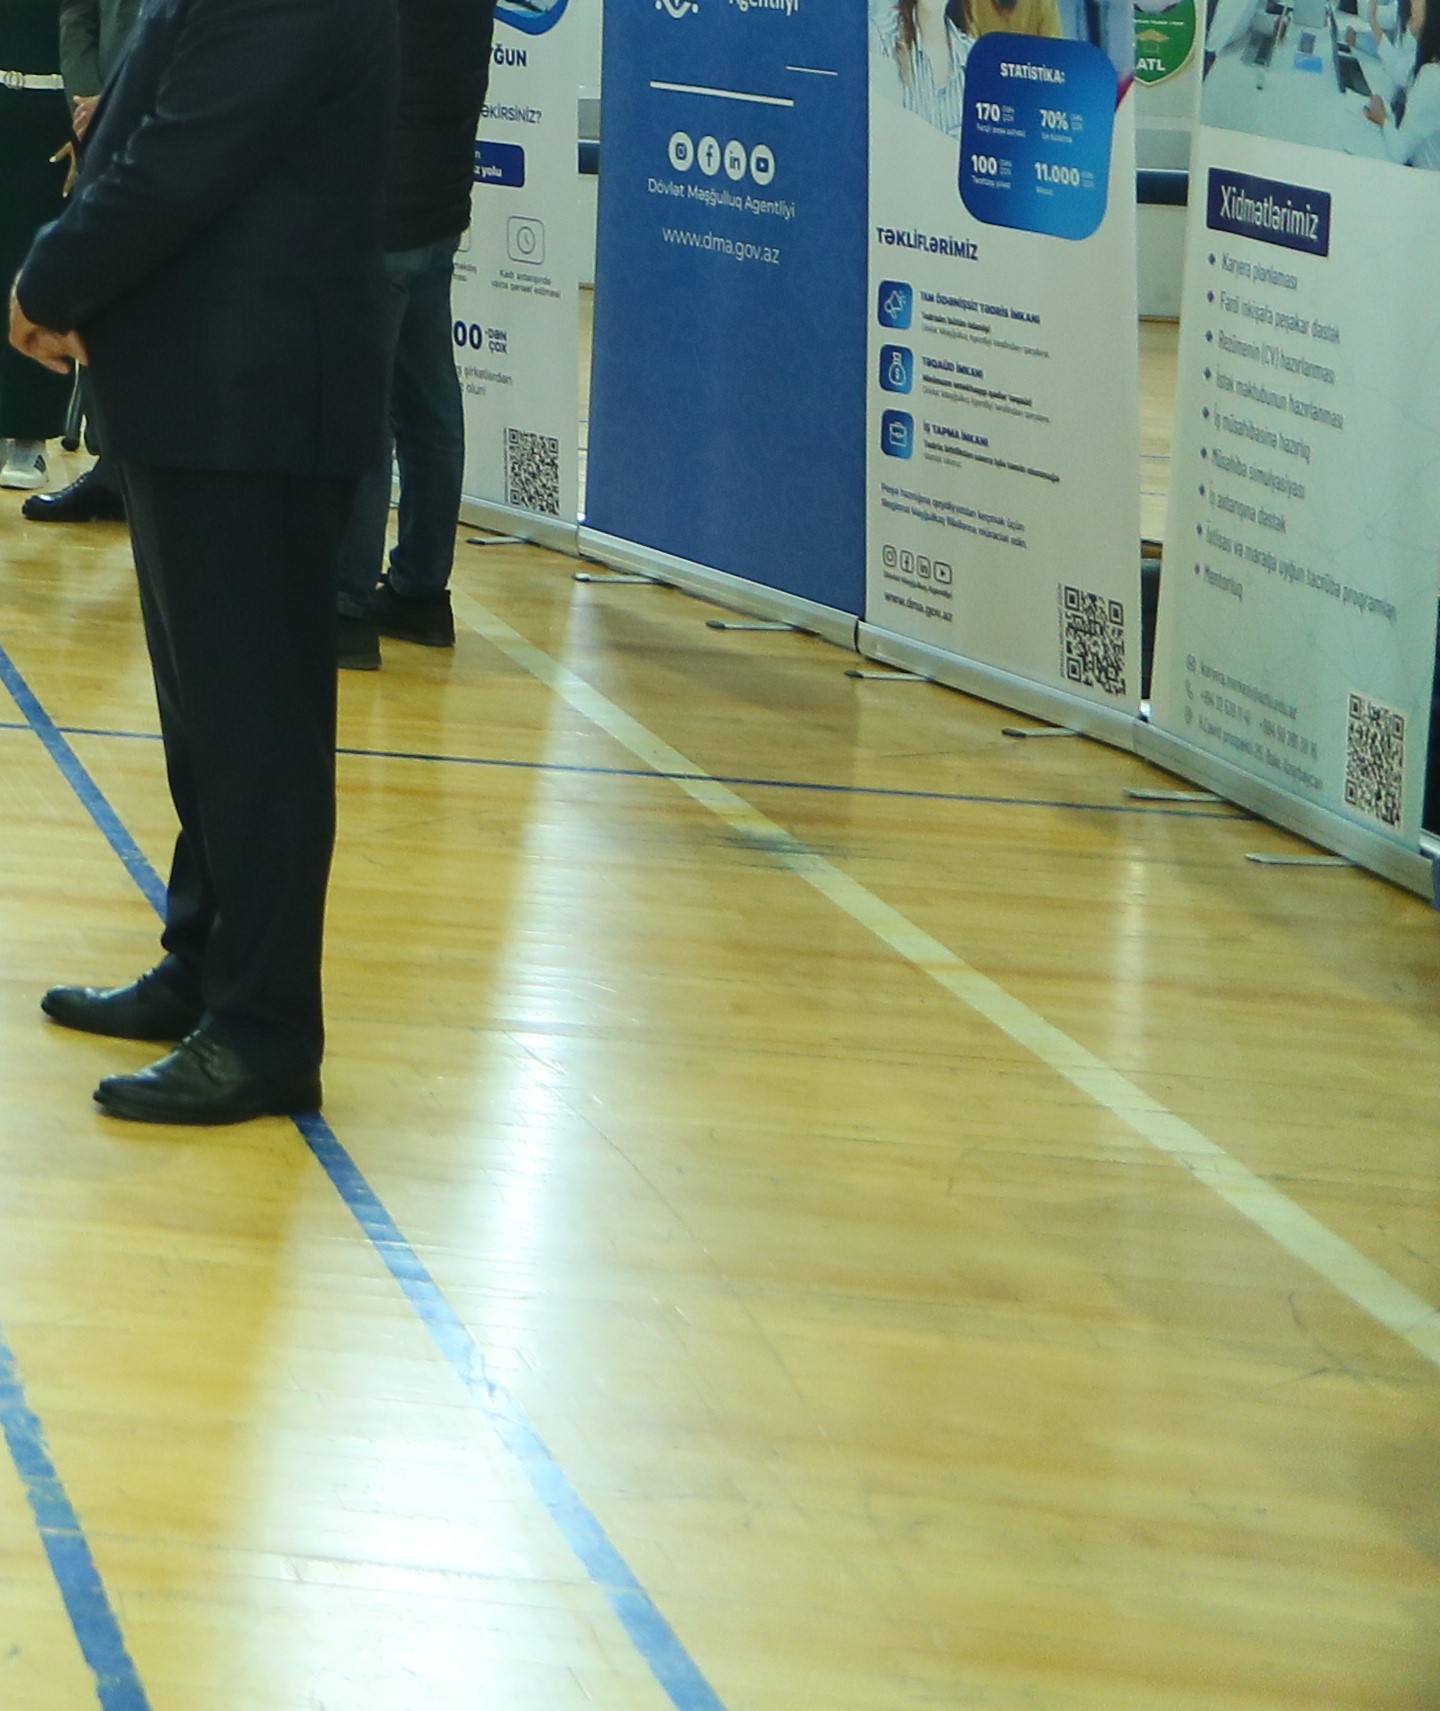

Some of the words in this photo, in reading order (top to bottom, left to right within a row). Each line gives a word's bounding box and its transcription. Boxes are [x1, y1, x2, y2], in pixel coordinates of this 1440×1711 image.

[999, 62, 1066, 84] STATİSTİKA:
[1136, 58, 1166, 71] ATL
[481, 104, 542, 124] ƏKİRSİNİZ?
[976, 102, 1001, 122] 170
[1039, 108, 1069, 131] 70%
[971, 154, 998, 175] 100
[1034, 162, 1080, 187] 11.000
[647, 178, 685, 198] Dövlət
[687, 185, 743, 211] Məşğulluq
[744, 195, 796, 221] Agentliyi
[1220, 184, 1320, 240] Xidmətlərimiz
[662, 227, 781, 264] www.dma.gov.az
[876, 227, 979, 261] TƏKLİFLƏRİMİZ
